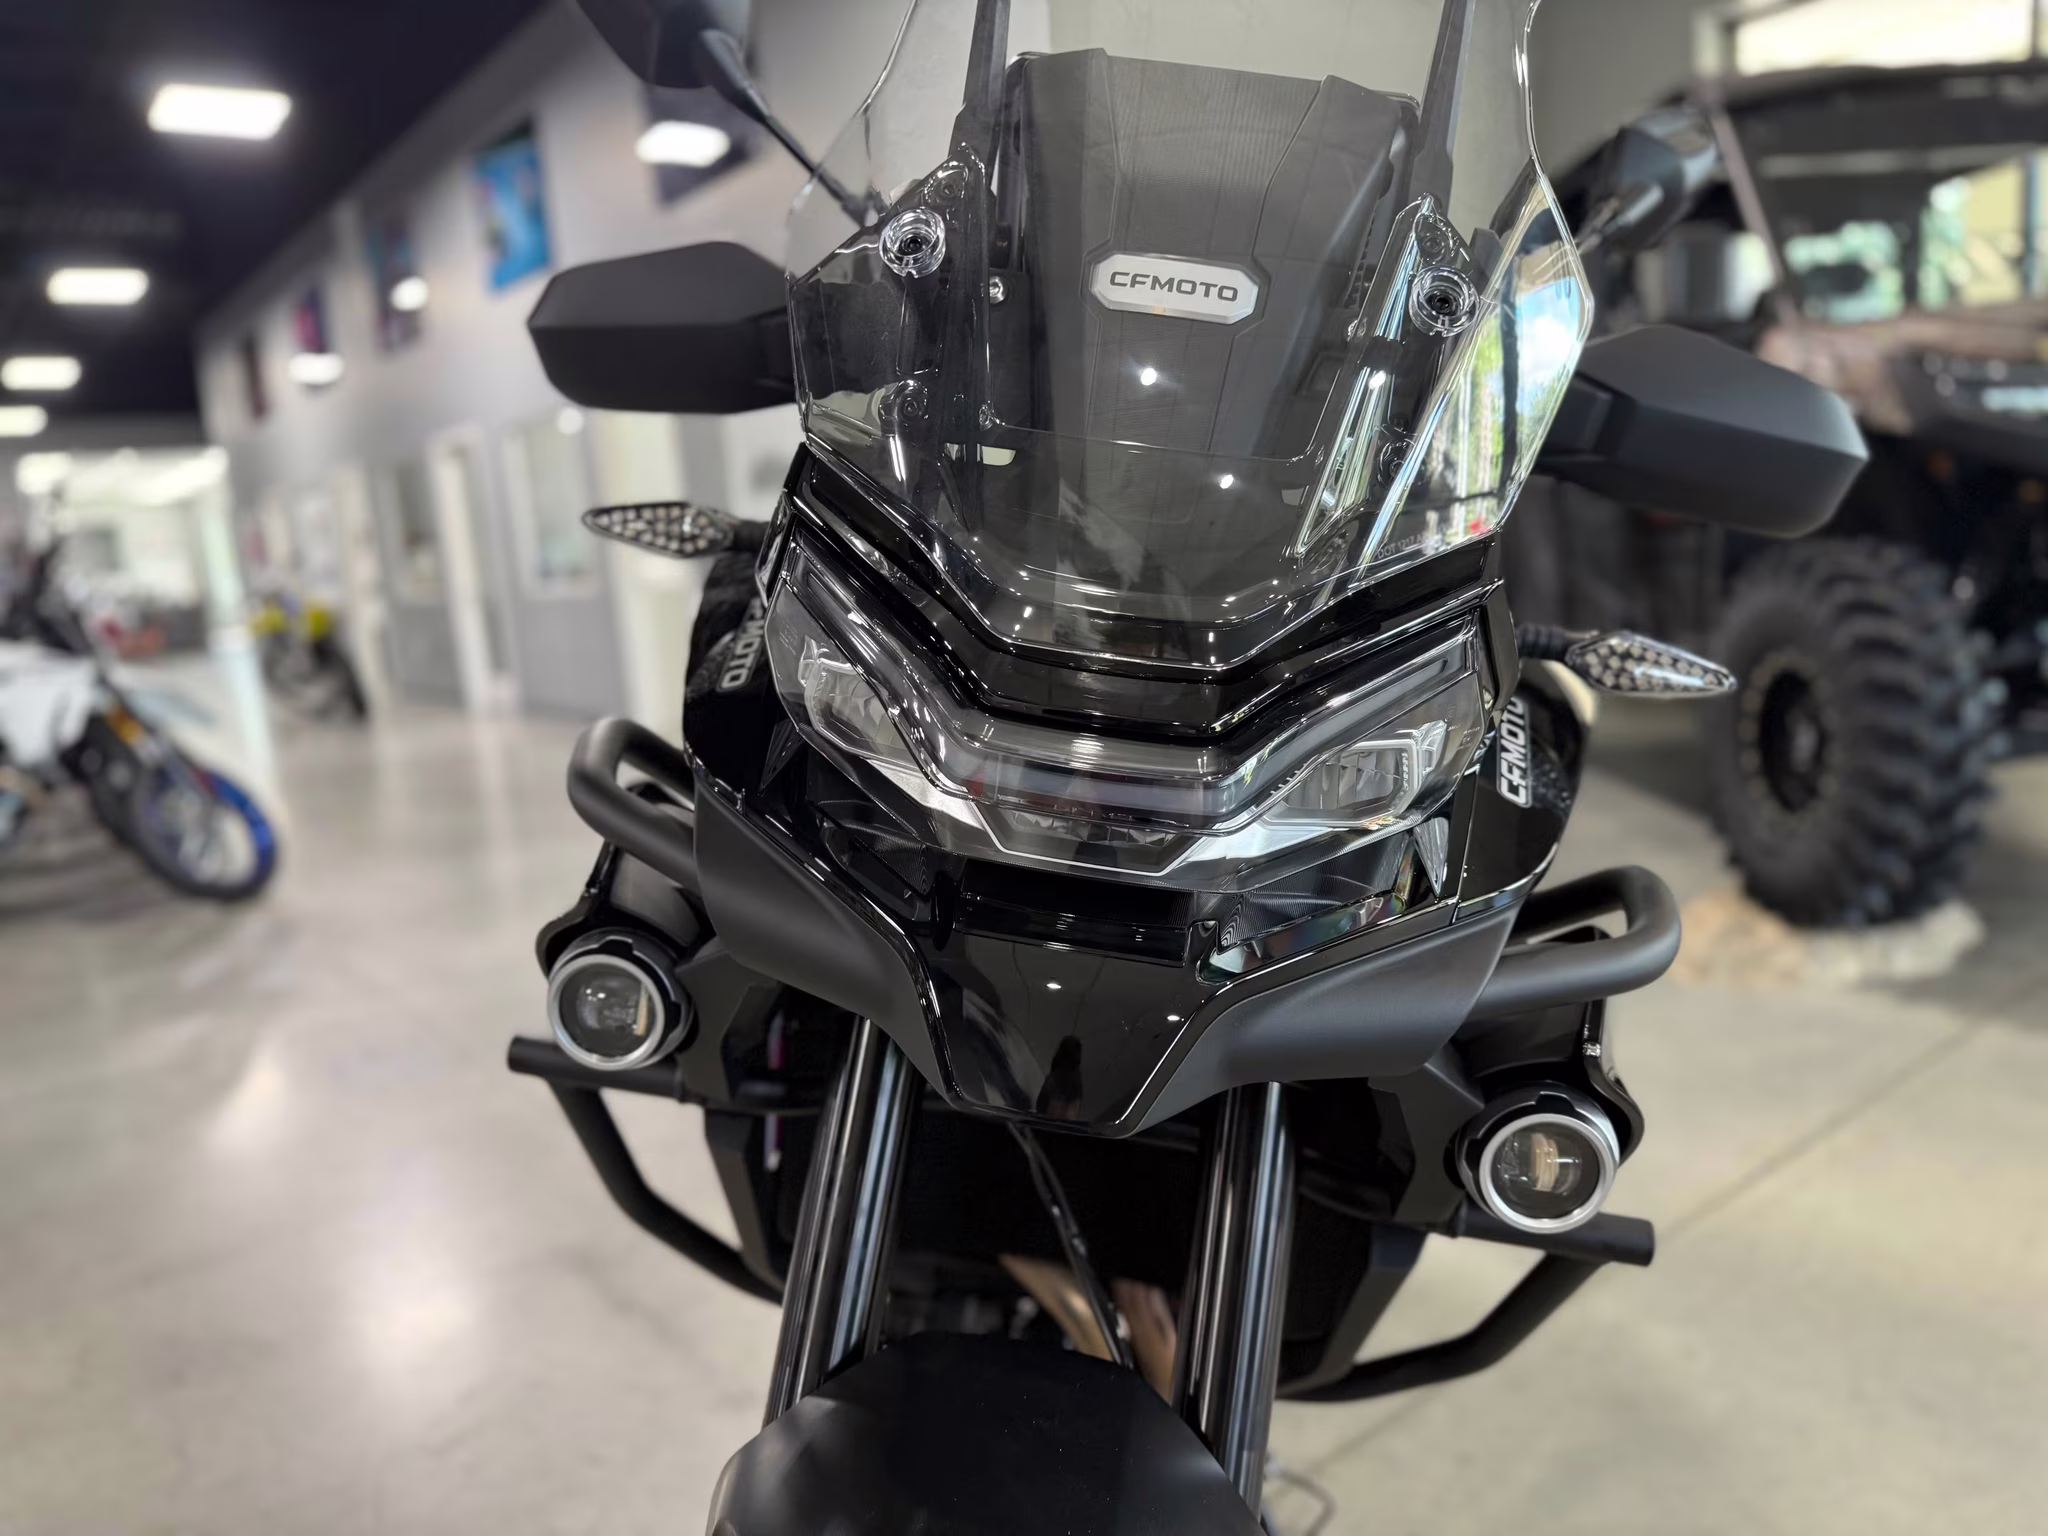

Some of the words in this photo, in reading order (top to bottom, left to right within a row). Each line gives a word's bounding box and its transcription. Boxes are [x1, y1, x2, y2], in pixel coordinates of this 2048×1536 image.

[1109, 271, 1239, 302] CFMOTO
[1377, 542, 1396, 559] DOT
[720, 598, 764, 689] FMOTO
